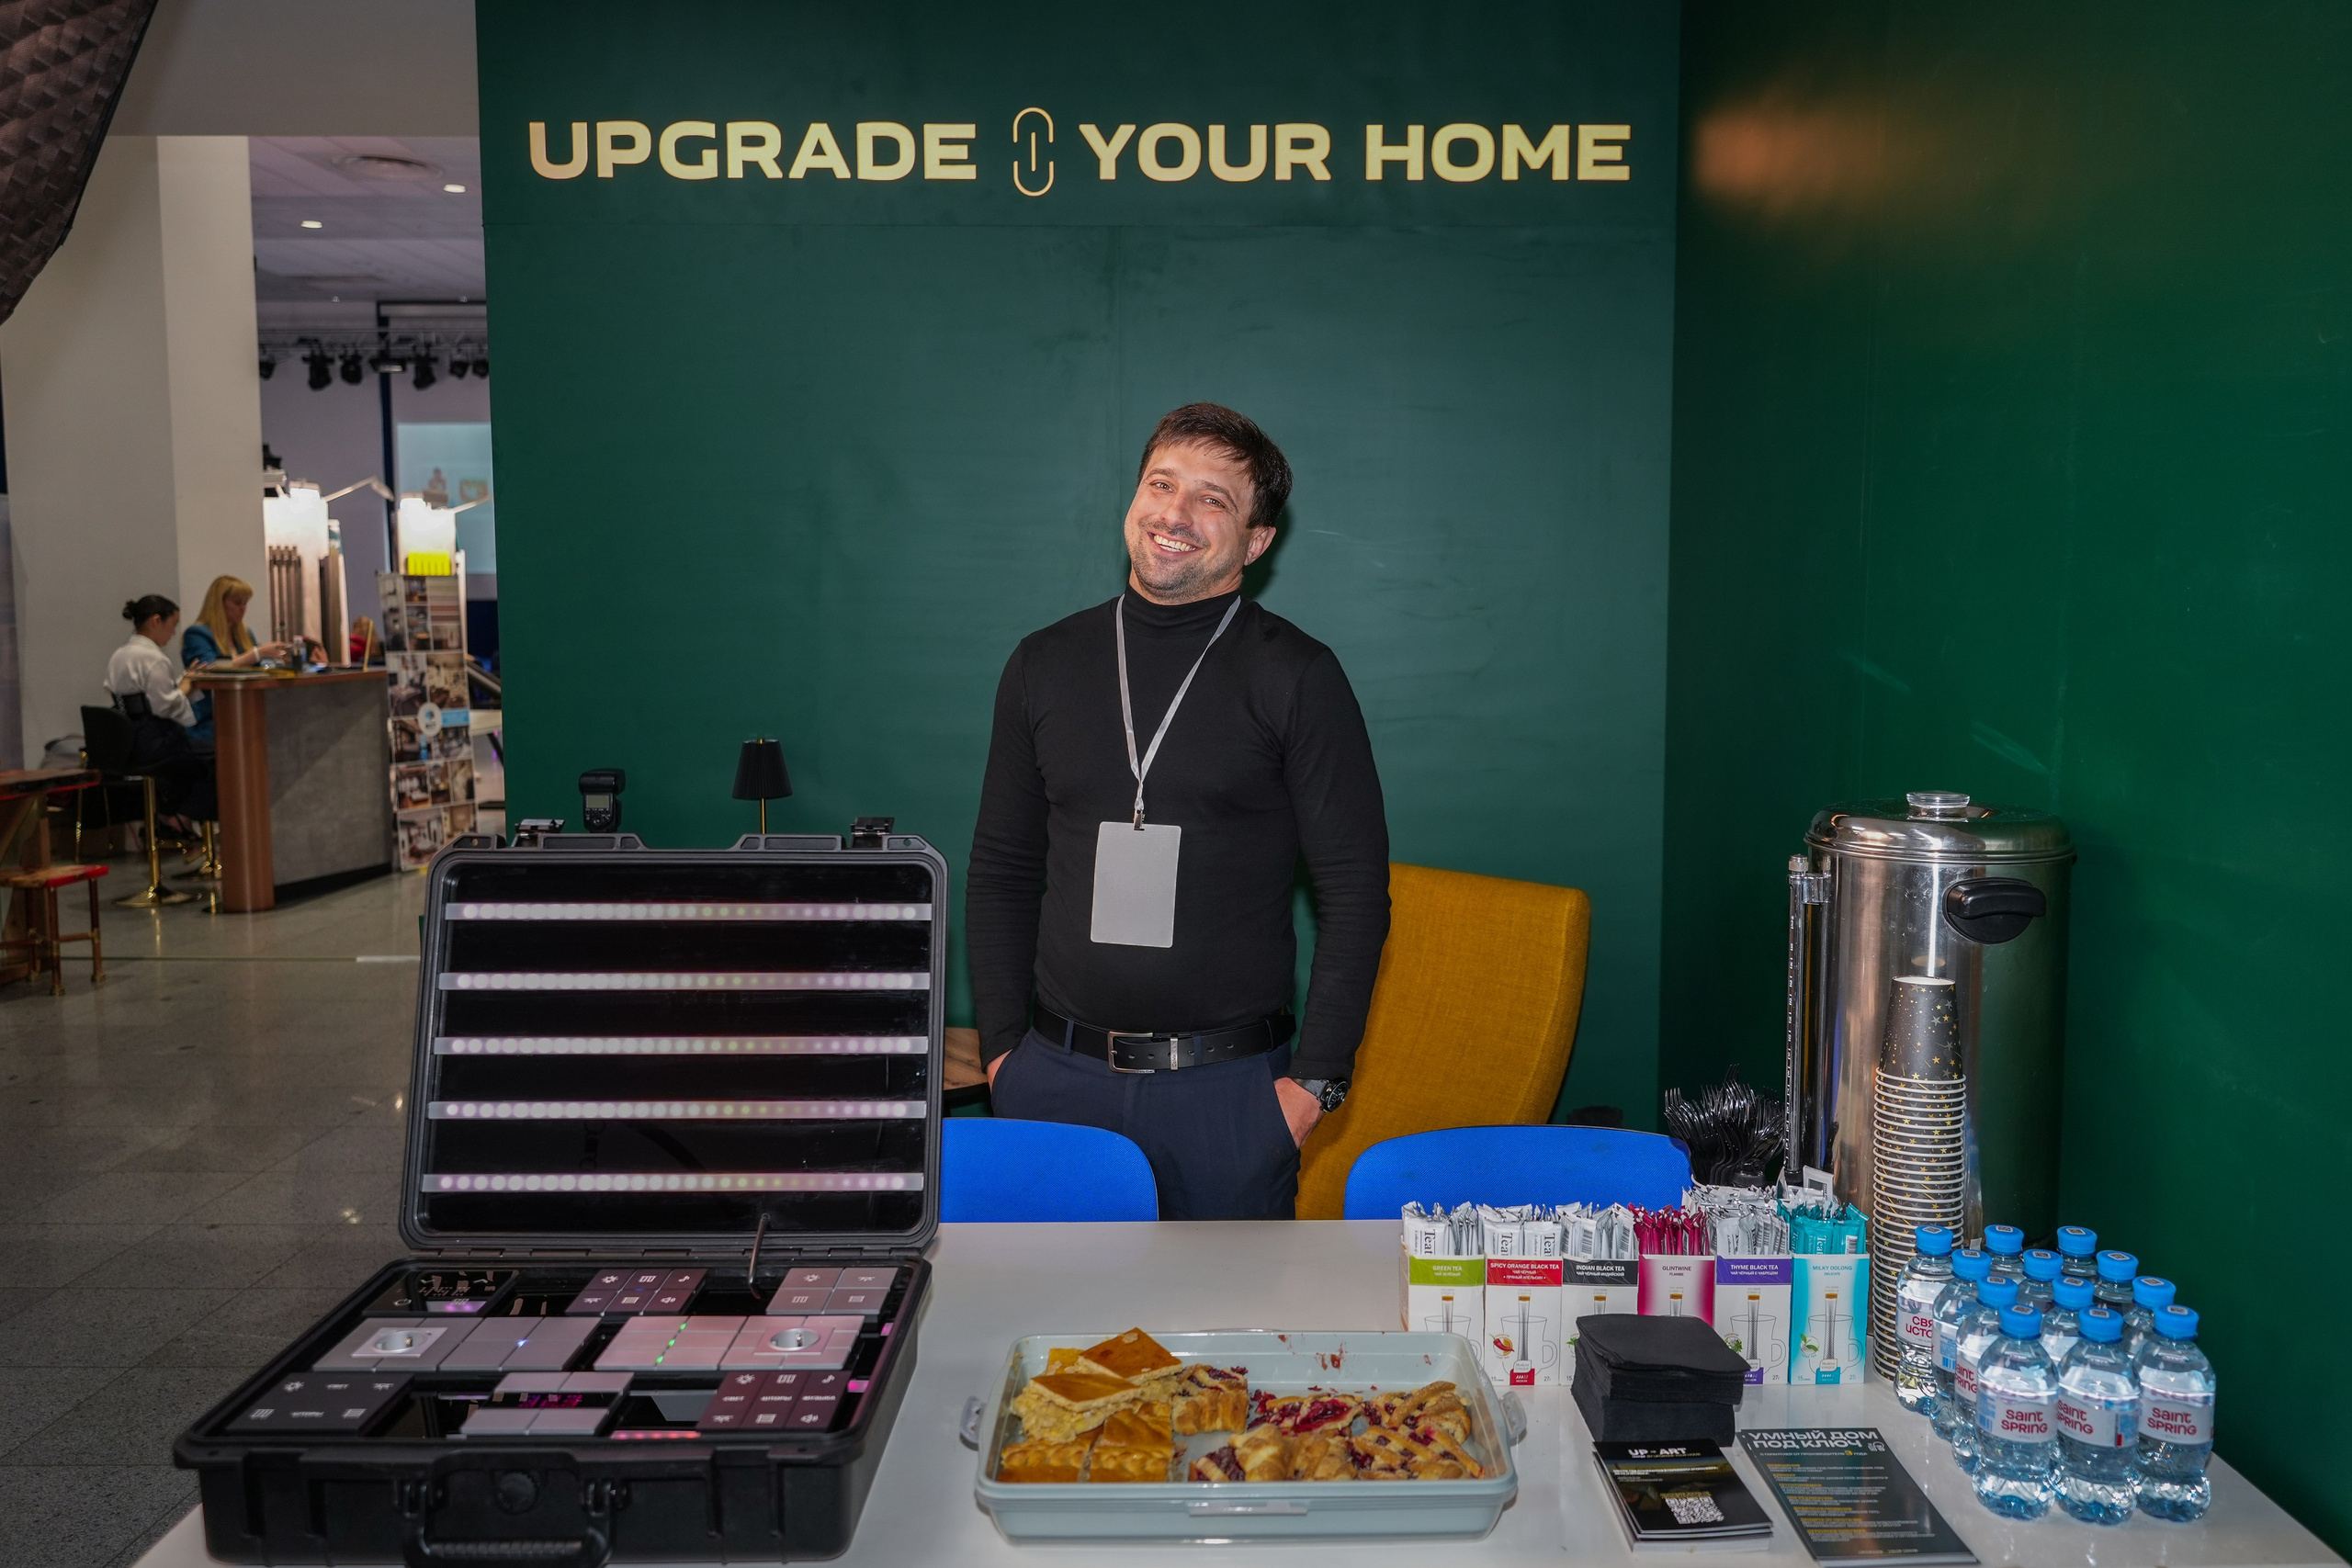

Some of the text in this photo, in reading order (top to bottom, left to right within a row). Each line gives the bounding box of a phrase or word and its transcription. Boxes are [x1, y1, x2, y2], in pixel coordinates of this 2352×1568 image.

[529, 120, 1632, 182] UPGRADE YOUR HOME
[1956, 1364, 1974, 1381] aint
[1955, 1374, 1978, 1393] RING
[2006, 1409, 2043, 1423] Saint
[2058, 1399, 2087, 1422] Saint
[2151, 1407, 2192, 1425] Saint
[2001, 1419, 2049, 1434] SPRING
[2147, 1417, 2198, 1436] SPRING
[1747, 1430, 1879, 1441] УМНЫЙ ДОМ
[1659, 1447, 1687, 1455] ART
[1753, 1439, 1863, 1450] ПОД КЛЮЧ
